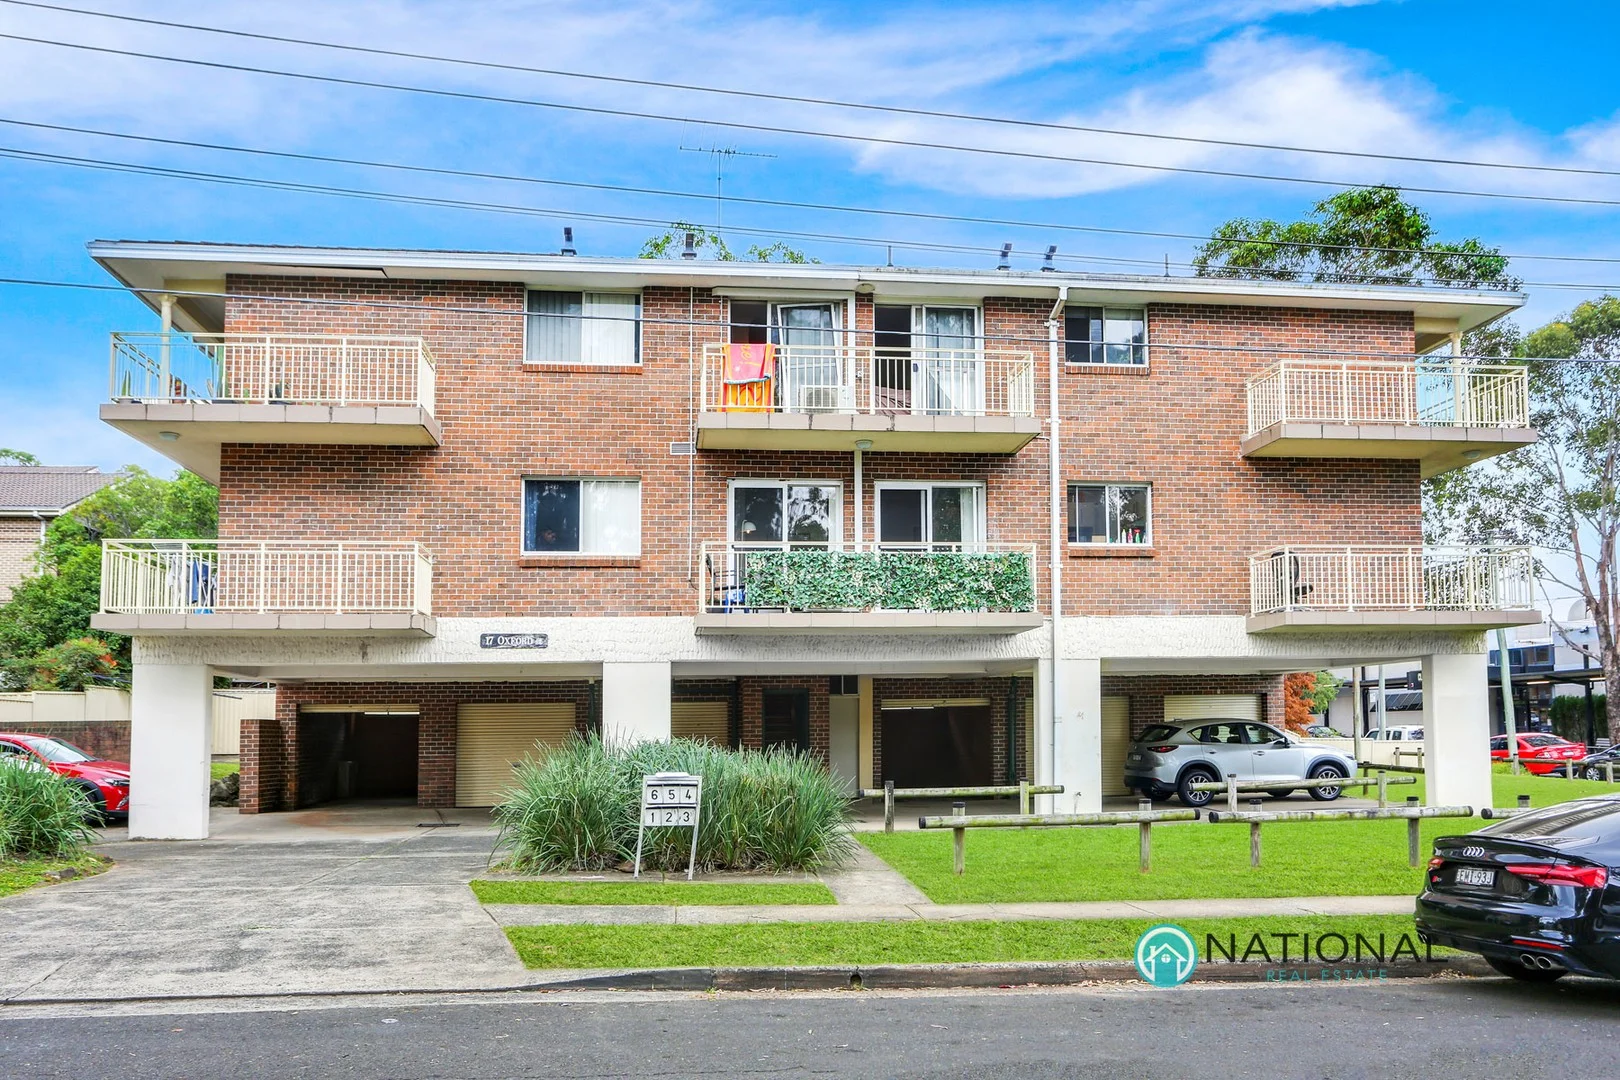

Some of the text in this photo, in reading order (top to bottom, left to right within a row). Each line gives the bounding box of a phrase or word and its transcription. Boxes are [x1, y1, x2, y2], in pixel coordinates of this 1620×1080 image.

[485, 636, 494, 645] 17
[651, 789, 692, 800] 6 5 4
[651, 811, 690, 823] 1 2 3
